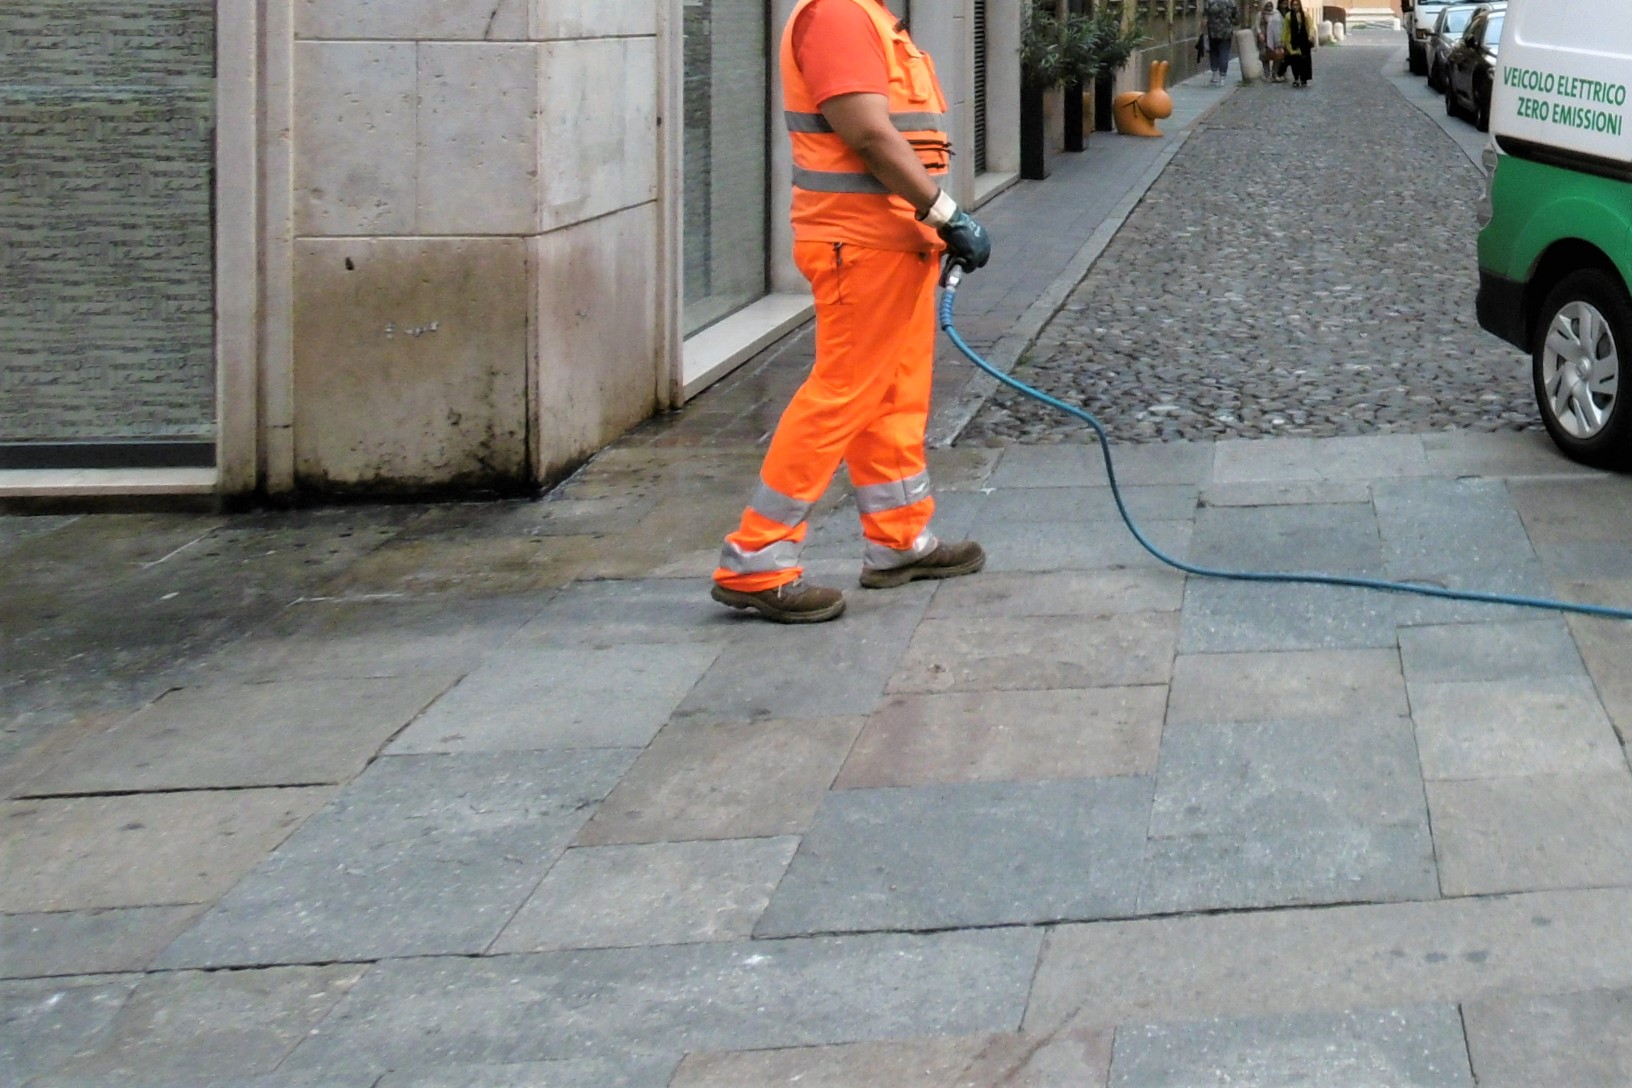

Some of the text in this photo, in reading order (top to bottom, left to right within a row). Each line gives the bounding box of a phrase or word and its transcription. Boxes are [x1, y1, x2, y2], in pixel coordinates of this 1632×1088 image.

[1503, 65, 1627, 106] VEICOLO ELETTRICO
[1516, 96, 1623, 136] ZERO EMISSIONI
